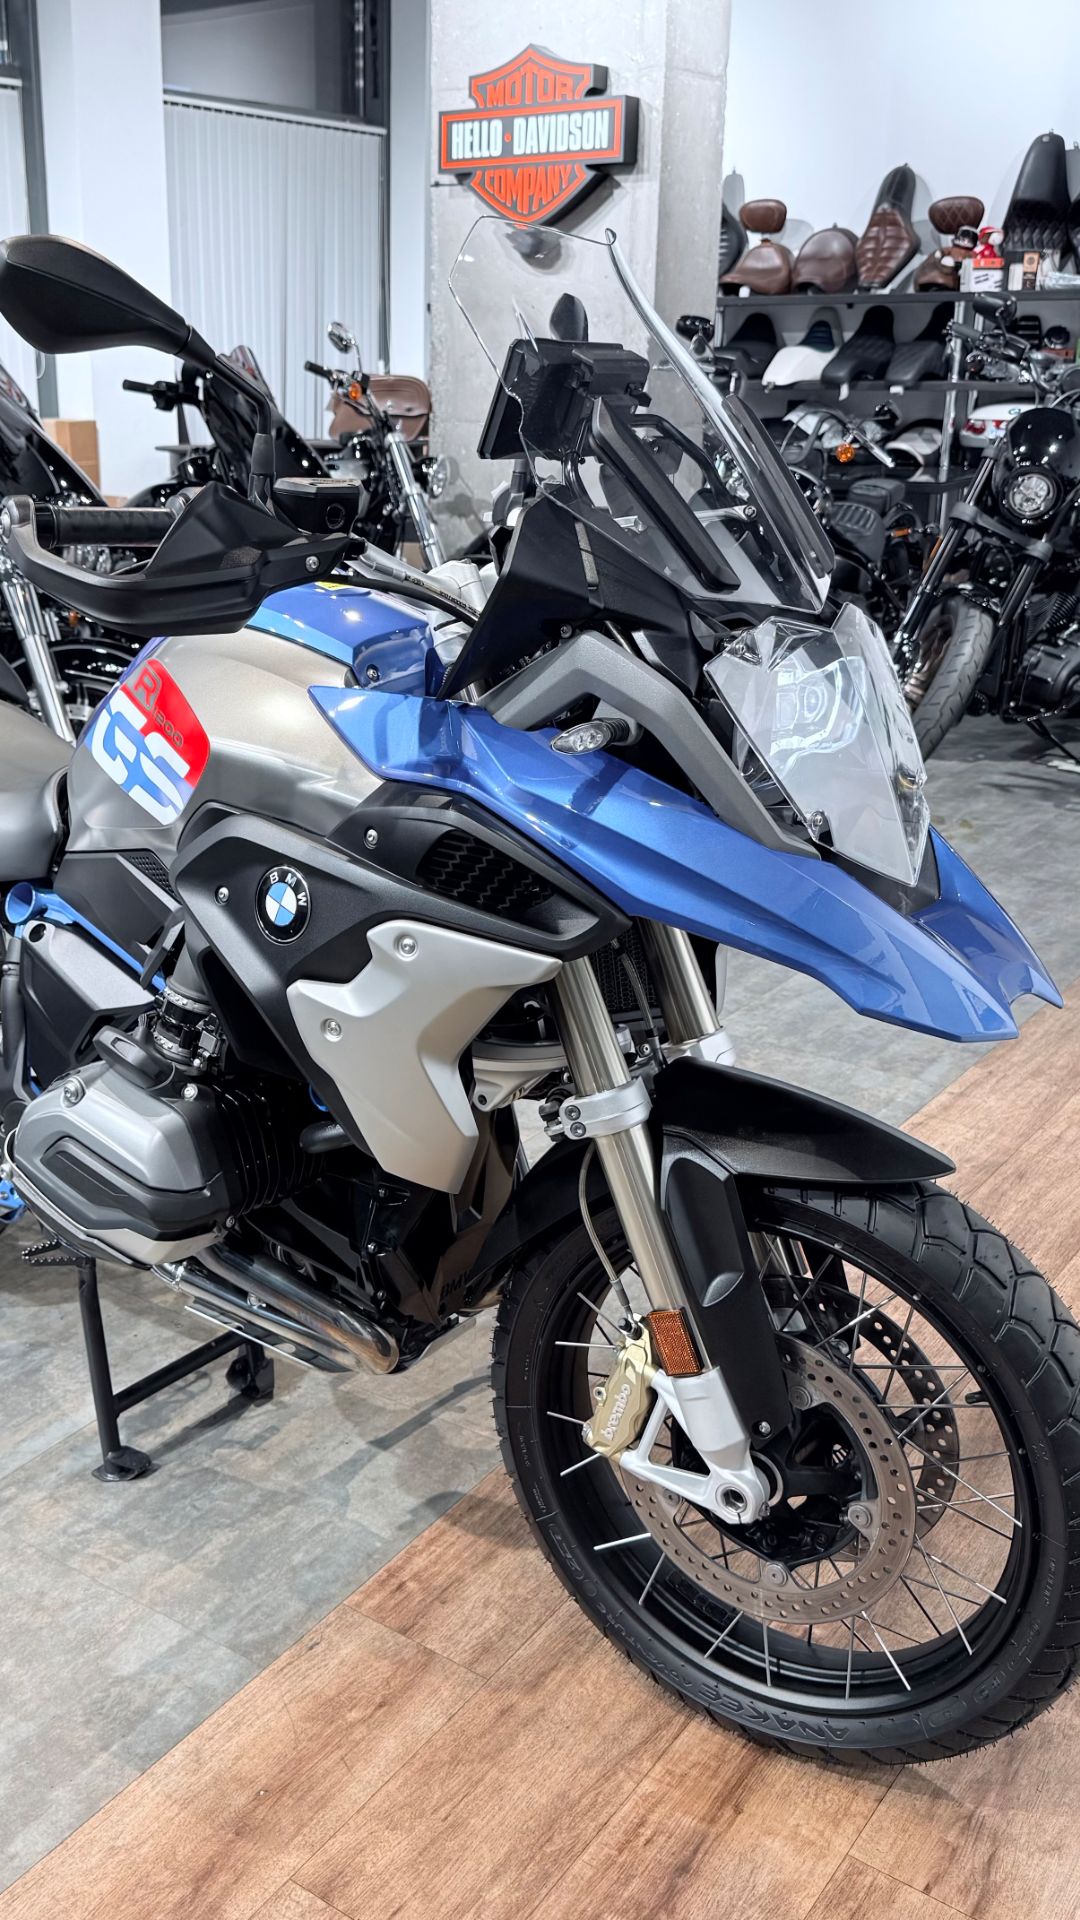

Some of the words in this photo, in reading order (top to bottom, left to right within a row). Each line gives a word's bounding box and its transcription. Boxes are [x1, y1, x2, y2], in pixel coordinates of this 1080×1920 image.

[486, 61, 574, 107] MOTOR
[451, 118, 503, 160] HELLO
[513, 109, 610, 155] DAVIDSON
[484, 164, 573, 215] COMPANY
[269, 871, 308, 906] BMW
[601, 1383, 631, 1441] brembo
[698, 1682, 850, 1740] ANAKEE
